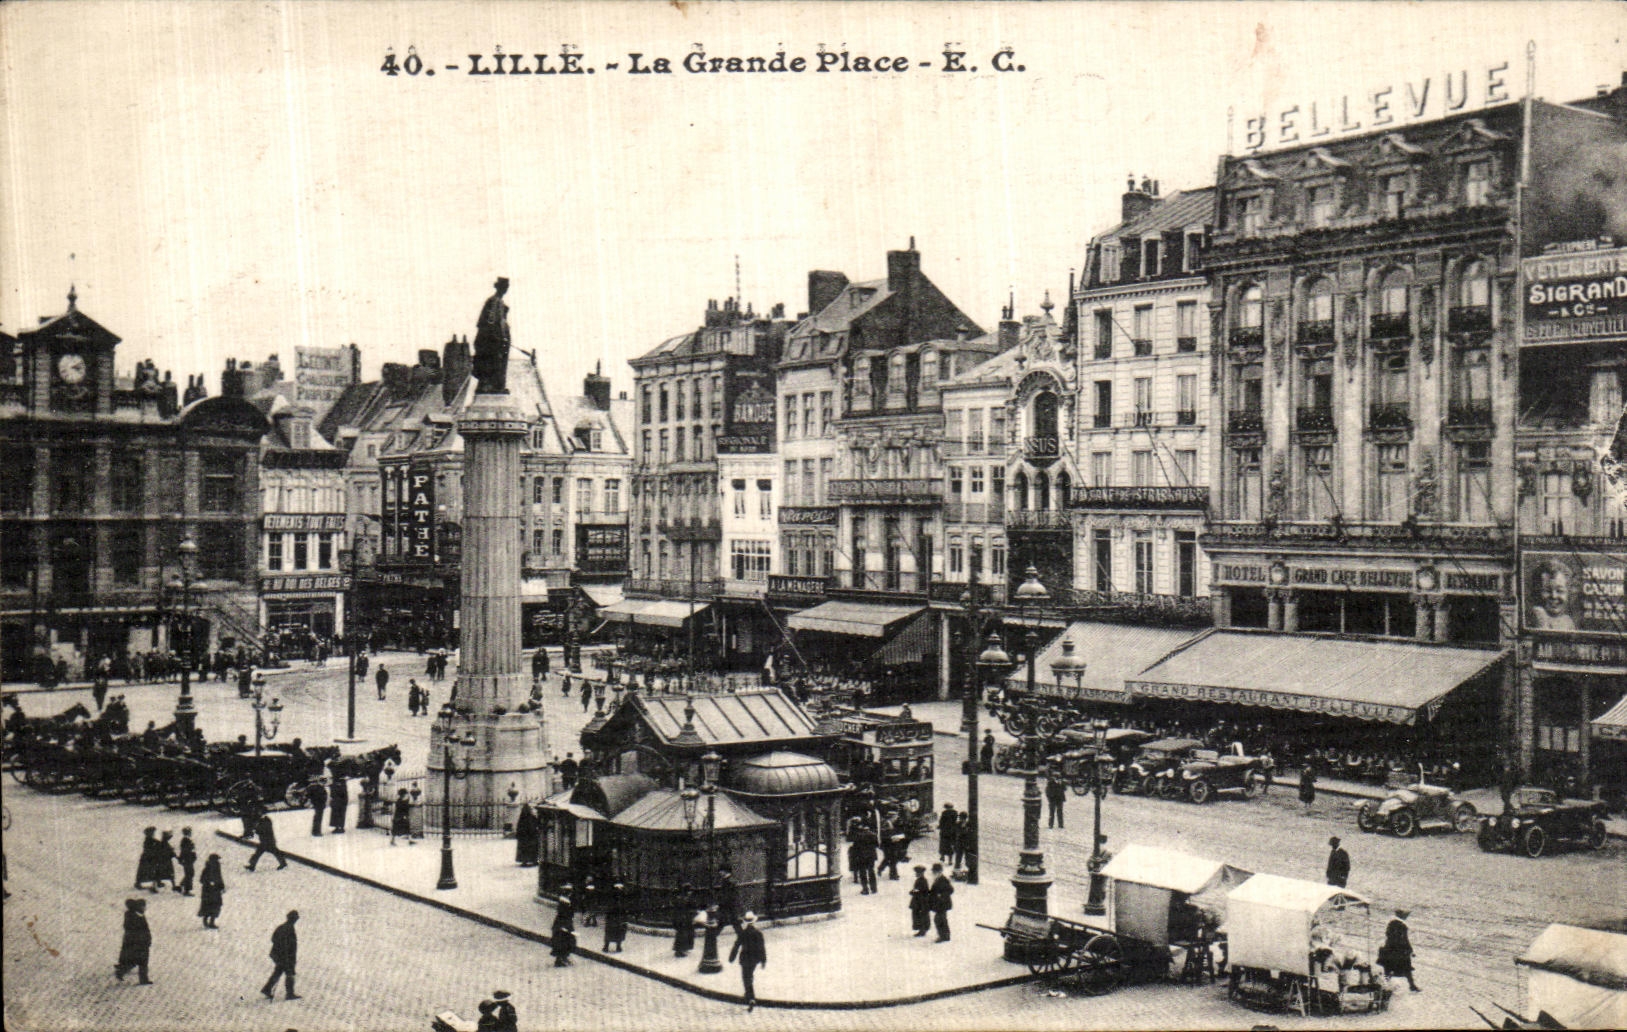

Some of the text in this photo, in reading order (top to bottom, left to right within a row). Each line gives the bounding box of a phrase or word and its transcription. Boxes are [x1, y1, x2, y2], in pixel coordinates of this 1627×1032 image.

[1245, 60, 1510, 150] BELLEVUE
[1529, 276, 1627, 305] SIGRAND
[1224, 565, 1266, 581] HOTEL
[1294, 568, 1328, 584] GRAND
[1582, 567, 1625, 580] SAVON
[1140, 684, 1396, 717] GRAND RESTAURANT BELLEVUE
